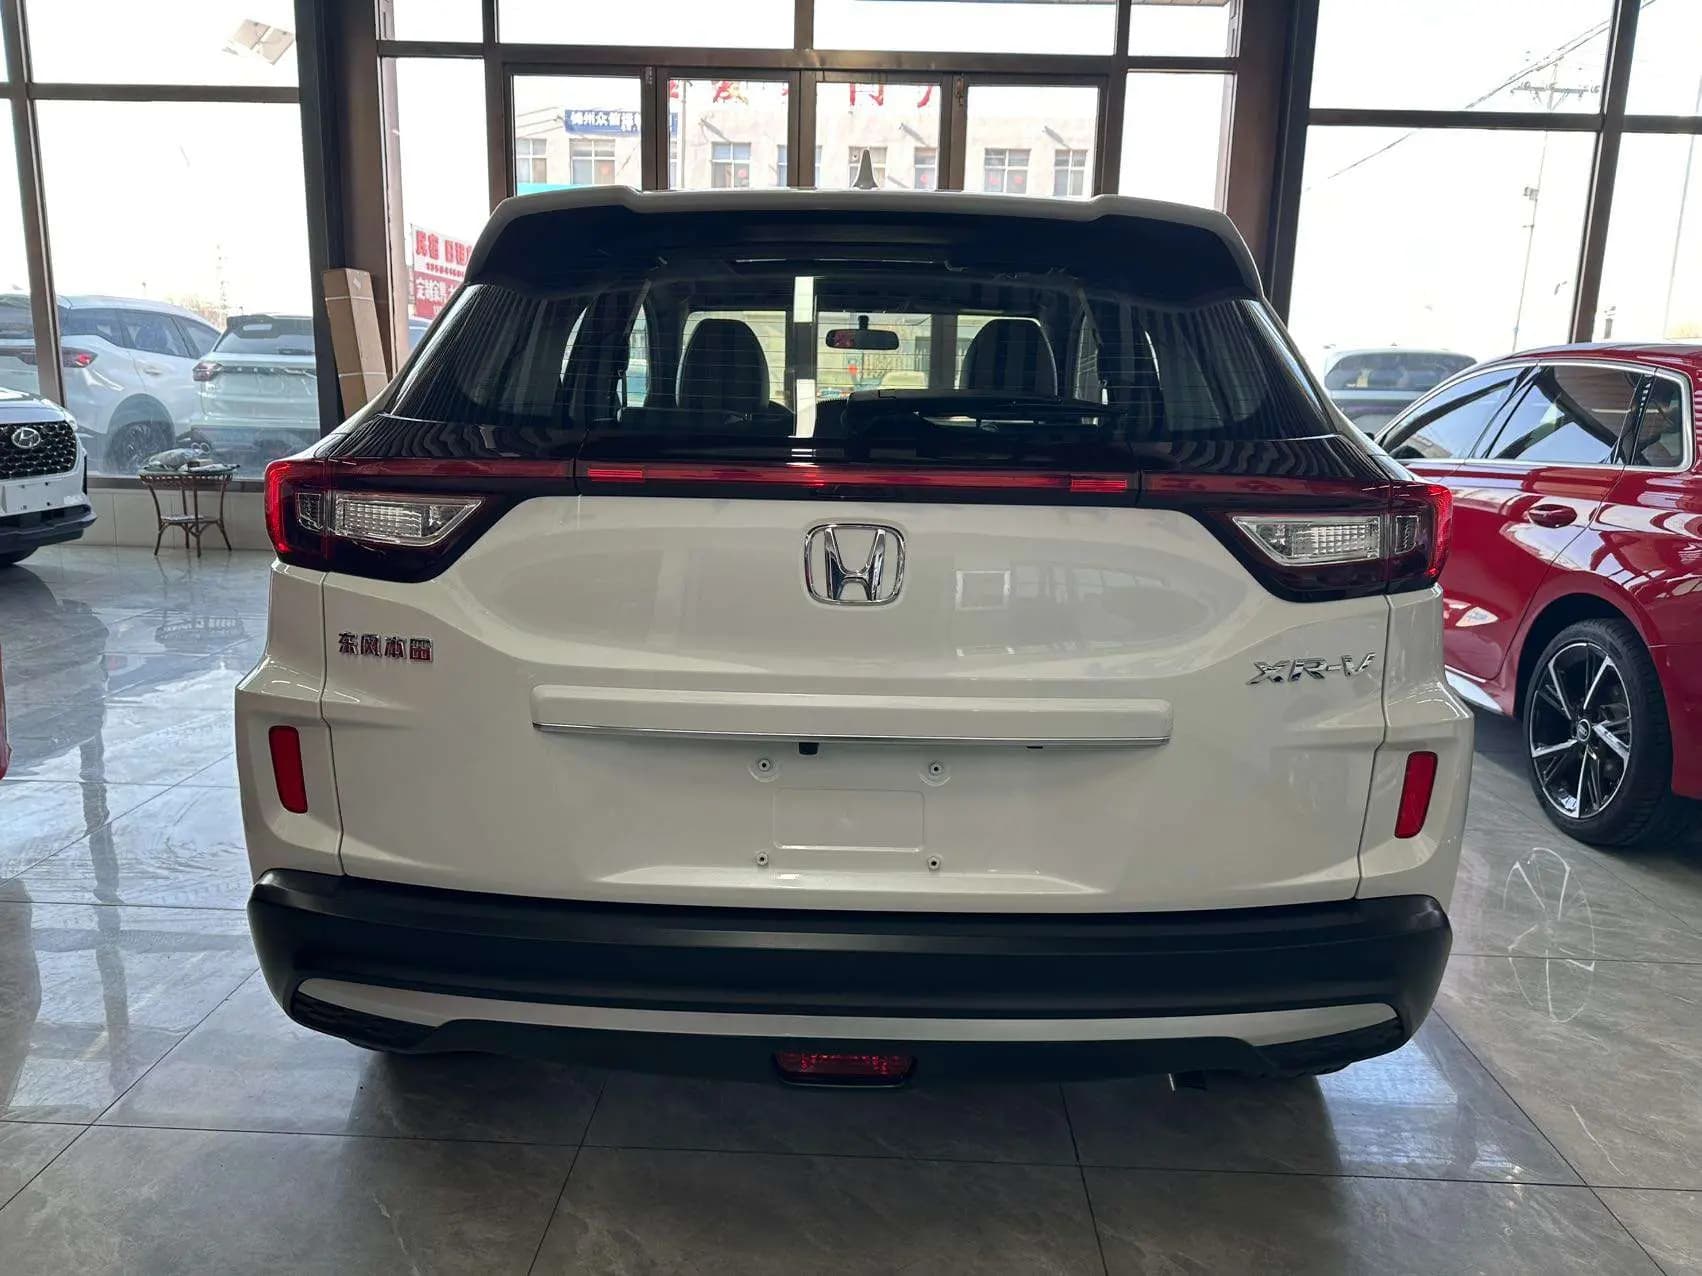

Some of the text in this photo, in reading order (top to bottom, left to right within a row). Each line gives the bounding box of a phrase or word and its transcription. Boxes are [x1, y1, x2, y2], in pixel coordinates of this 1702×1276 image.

[338, 631, 433, 662] 东风本田
[1246, 652, 1376, 685] XR-V
